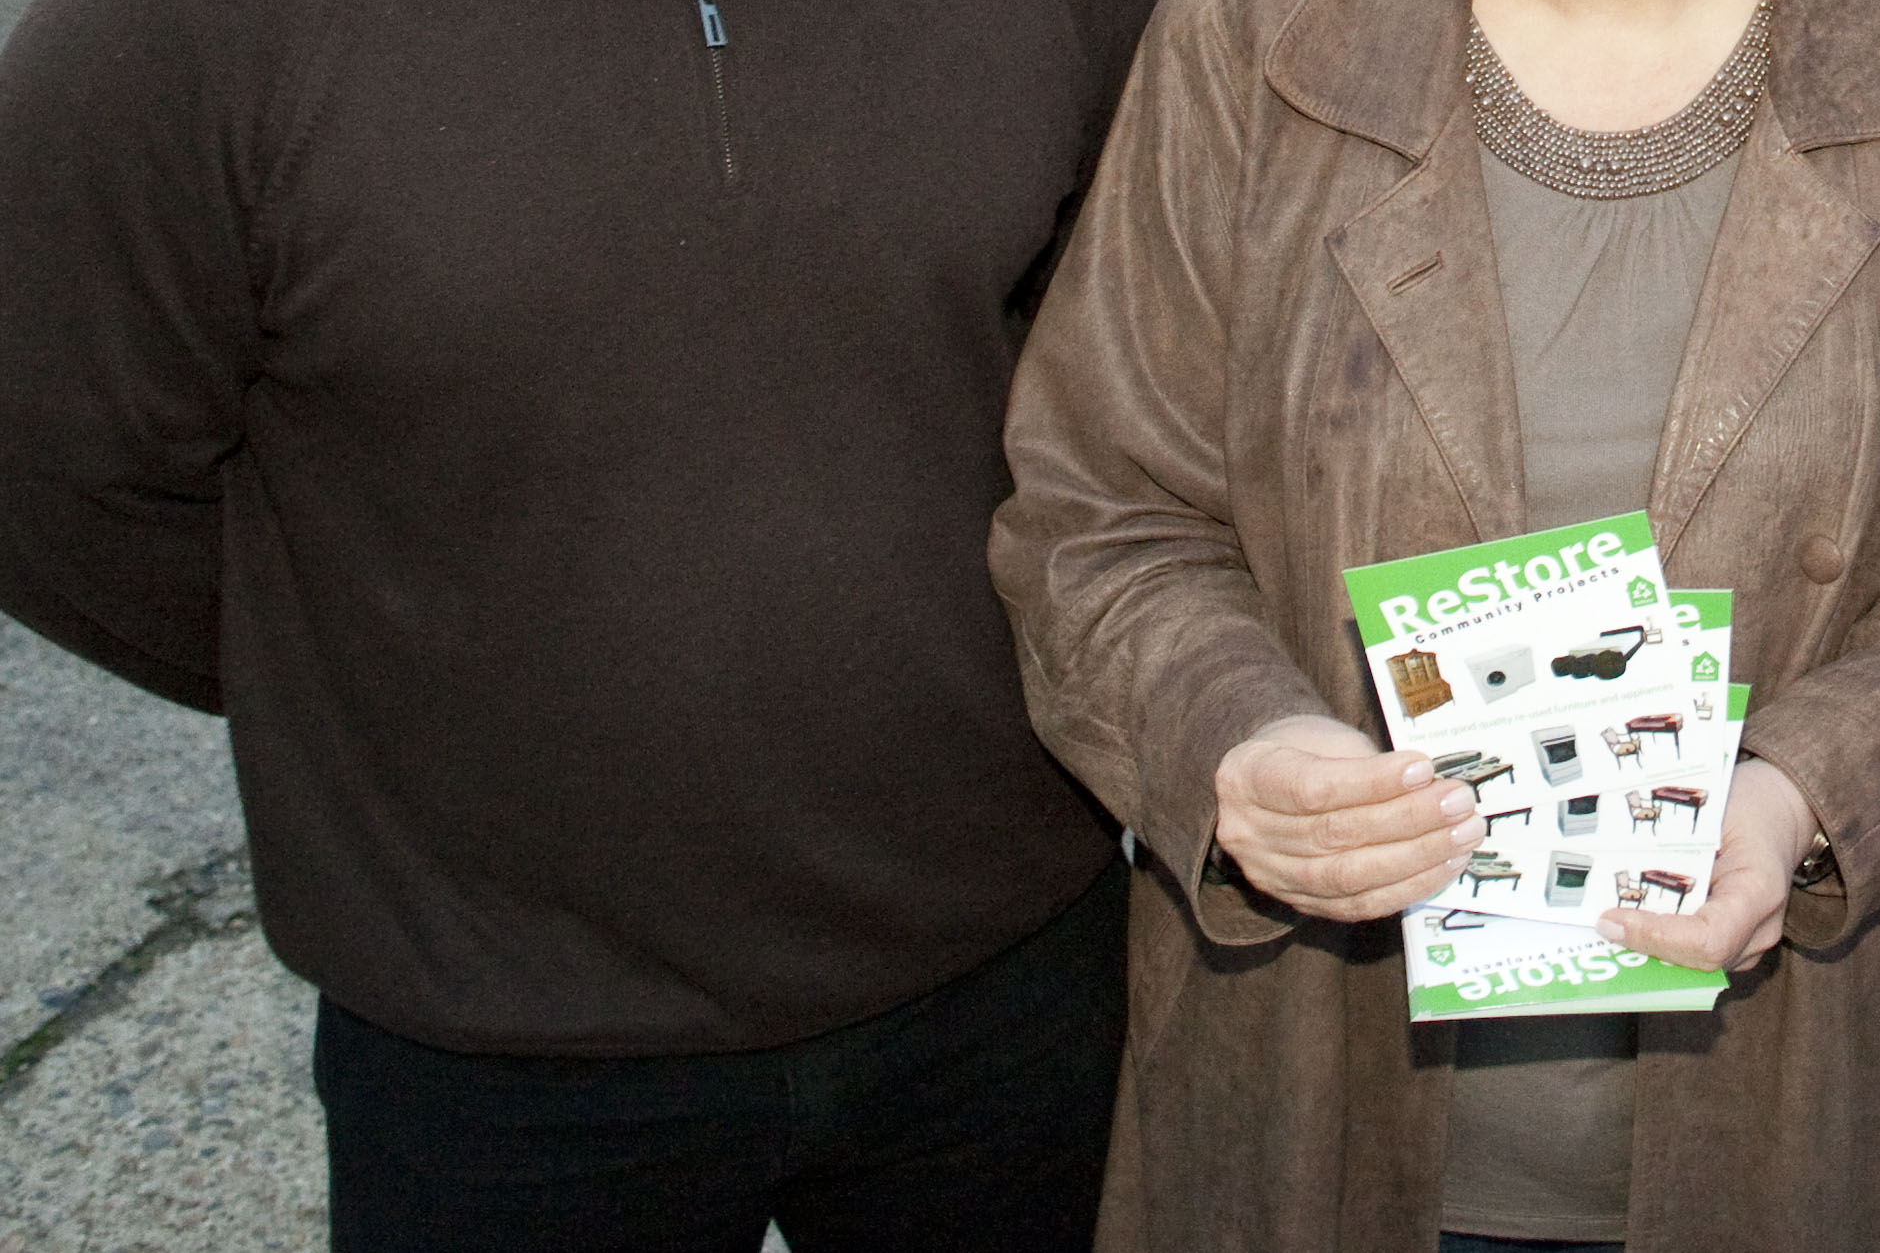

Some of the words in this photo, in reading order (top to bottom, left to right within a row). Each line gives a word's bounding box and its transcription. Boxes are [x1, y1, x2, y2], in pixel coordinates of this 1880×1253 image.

[1379, 532, 1627, 639] ReStore
[1414, 601, 1523, 645] Community
[1533, 566, 1620, 603] Projects
[1451, 721, 1477, 738] good
[1480, 714, 1512, 734] quality
[1553, 698, 1597, 716] furniture
[1600, 692, 1620, 706] and
[1621, 683, 1675, 704] appliances
[1457, 946, 1649, 1001] eStore
[1461, 952, 1547, 975] Projects
[1557, 940, 1605, 956] unity
